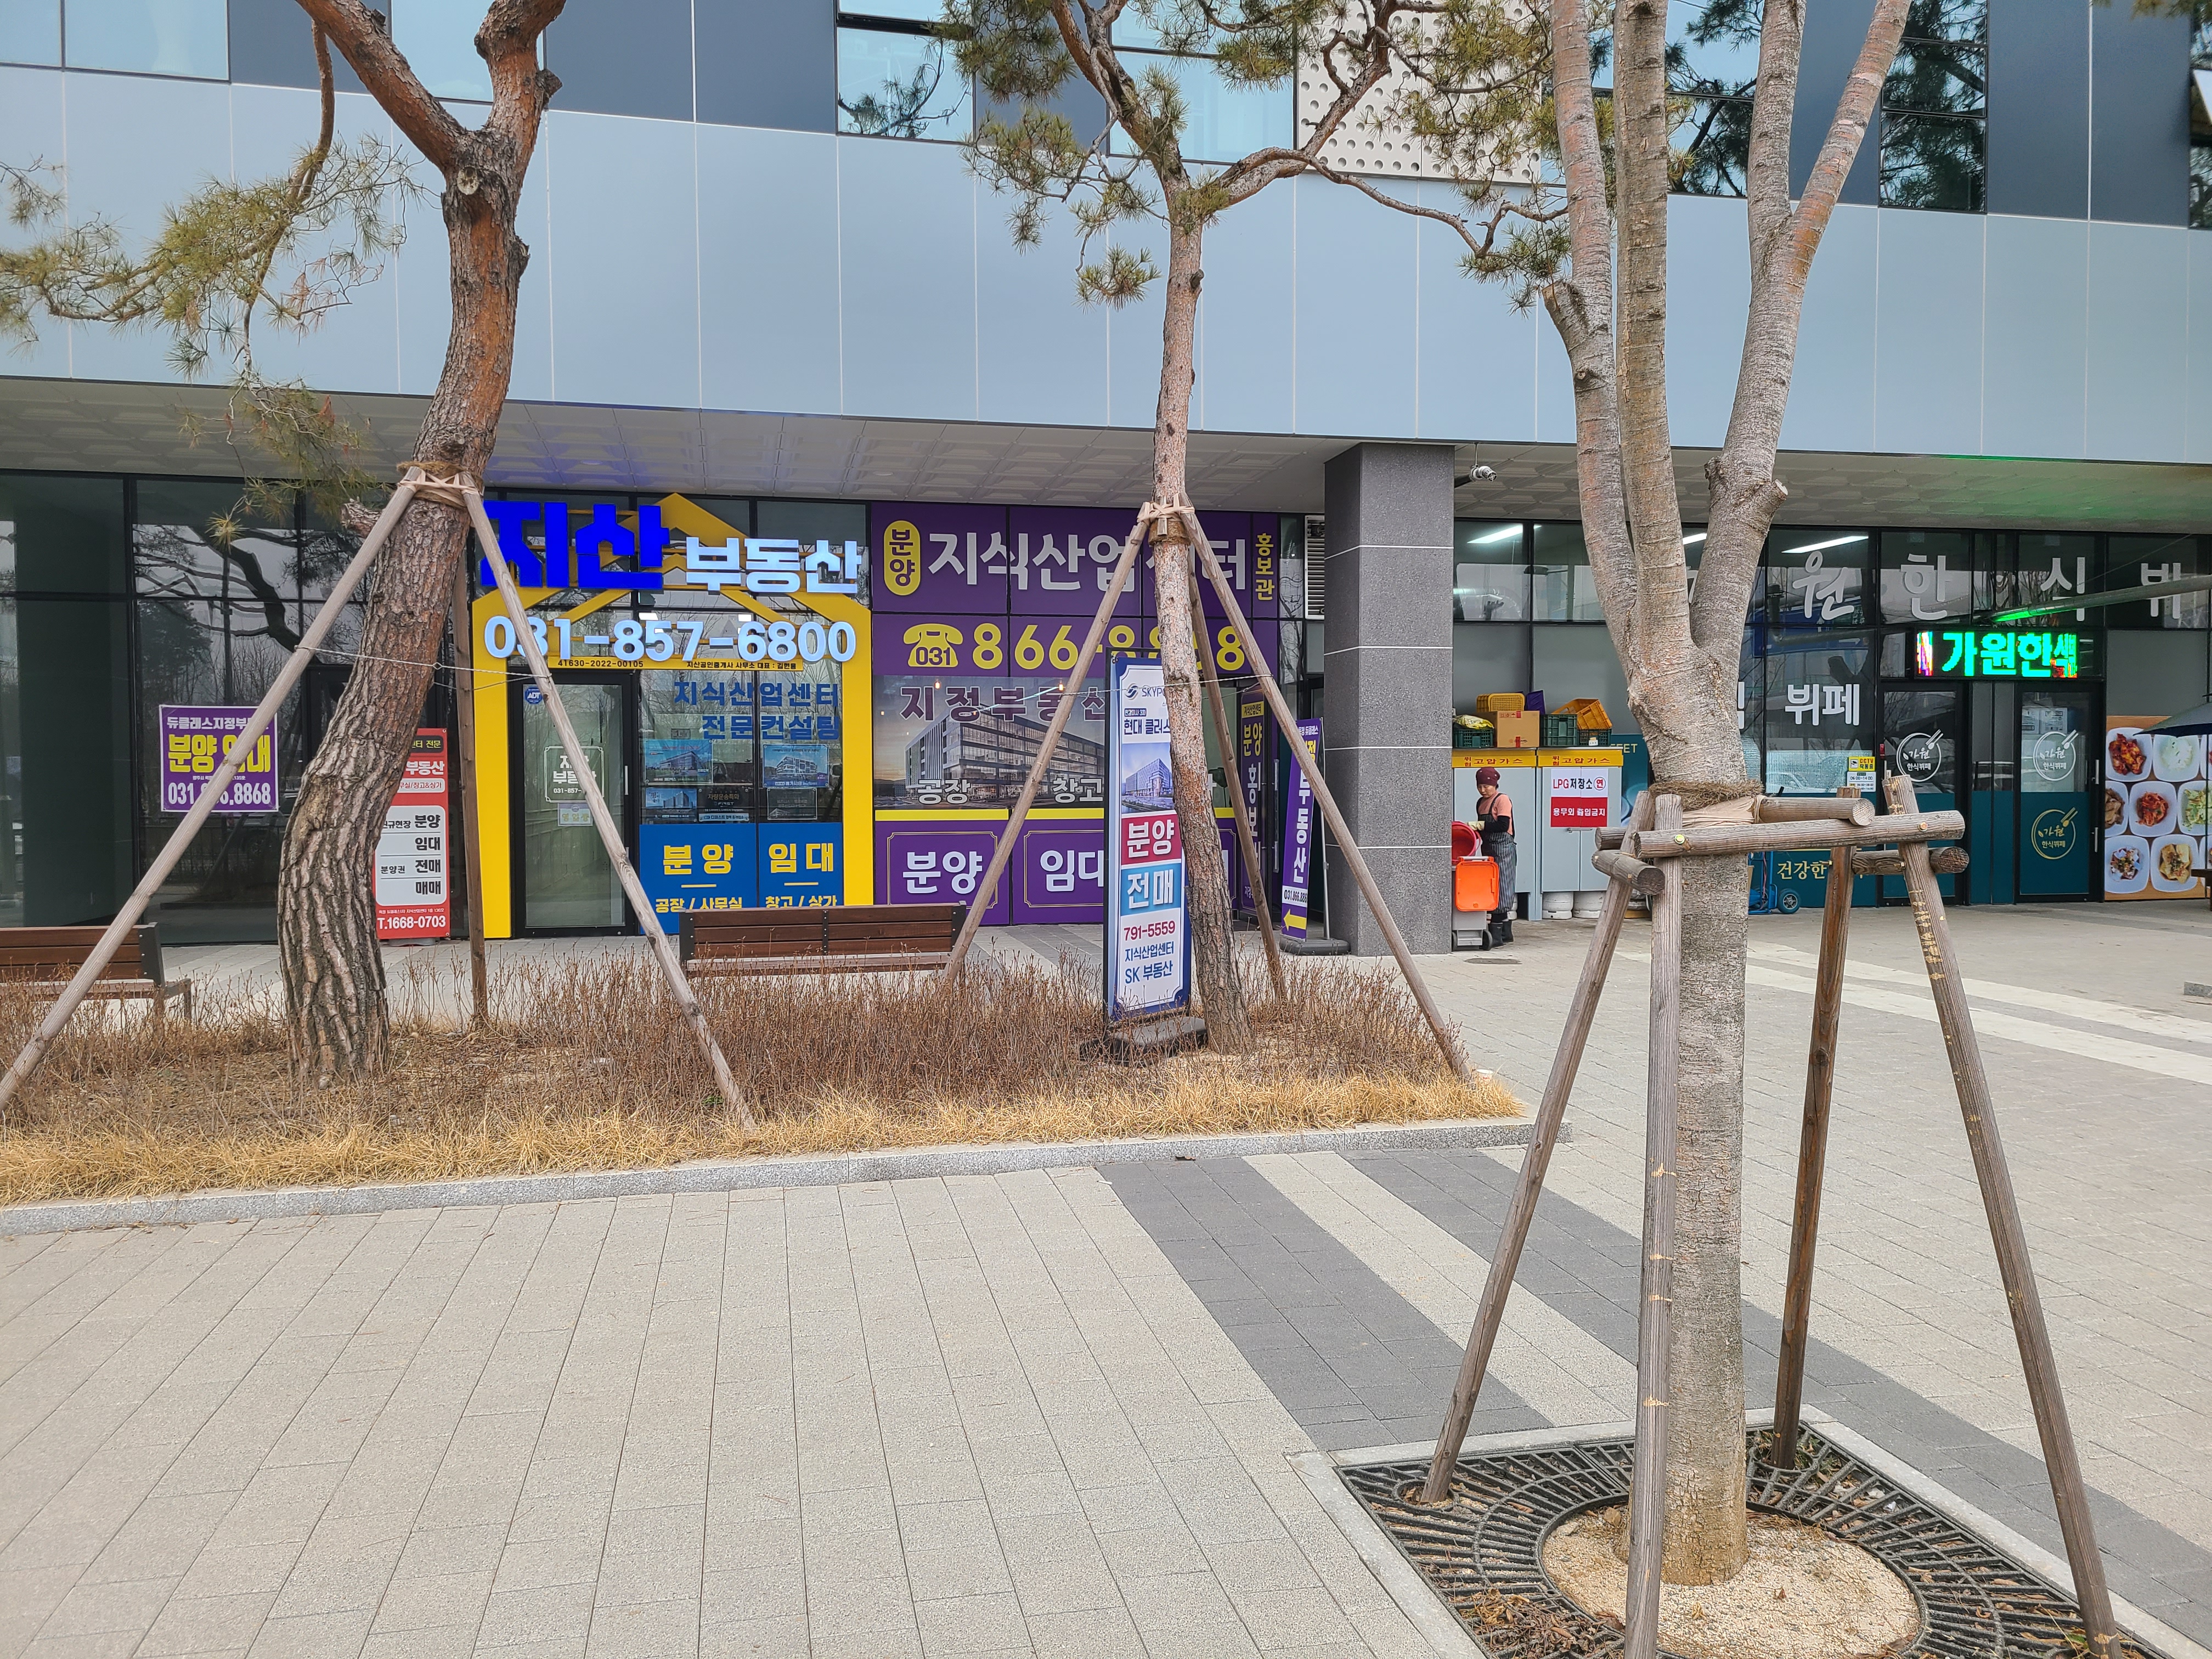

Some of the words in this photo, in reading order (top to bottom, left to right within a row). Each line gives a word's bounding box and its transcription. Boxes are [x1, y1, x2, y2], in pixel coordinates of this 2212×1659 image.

[481, 500, 670, 589] 지산
[686, 536, 861, 594] 부동산
[889, 529, 915, 586] 분양
[929, 532, 1245, 592] 지식산업터
[1256, 533, 1275, 601] 홍보관
[484, 616, 856, 662] 031-857-6800
[916, 646, 951, 665] 031
[674, 681, 838, 707] 지식산업센터
[167, 717, 269, 730] 듀클래스지정부
[702, 715, 839, 741] 전문컨설팅
[1124, 719, 1142, 735] 현대
[1243, 723, 1262, 757] 분양
[168, 734, 217, 772] 분양
[1909, 747, 1930, 759] 가원
[2045, 747, 2066, 759] 가원
[406, 761, 444, 775] 부동산
[1907, 763, 1931, 771] 한식뷔페
[2043, 762, 2067, 770] 한식뷔페
[917, 778, 971, 804] 공장
[1052, 778, 1103, 803] 창고
[415, 815, 441, 828] 분양
[562, 813, 589, 822] 영업중
[1553, 808, 1575, 816] 용무외
[1577, 808, 1605, 816] 출입금지
[1127, 819, 1175, 859] 분양
[2044, 825, 2064, 837] 가원
[415, 837, 441, 850] 임대
[381, 866, 405, 874] 분양권
[415, 859, 441, 873] 전매
[663, 843, 733, 874] 분양
[769, 843, 833, 873] 임대
[902, 851, 983, 894] 분양
[1777, 861, 1827, 879] 건강한
[416, 881, 441, 895] 매매
[1127, 869, 1173, 909] 전매
[656, 898, 685, 913] 공장
[700, 897, 743, 910] 사무실
[765, 896, 793, 908] 창고
[377, 915, 445, 929] T.1668-0703
[1124, 920, 1176, 941] 791-5559
[1125, 941, 1175, 962] 지식산업센터
[1125, 967, 1140, 984] SK
[1143, 961, 1173, 980] 부동산
